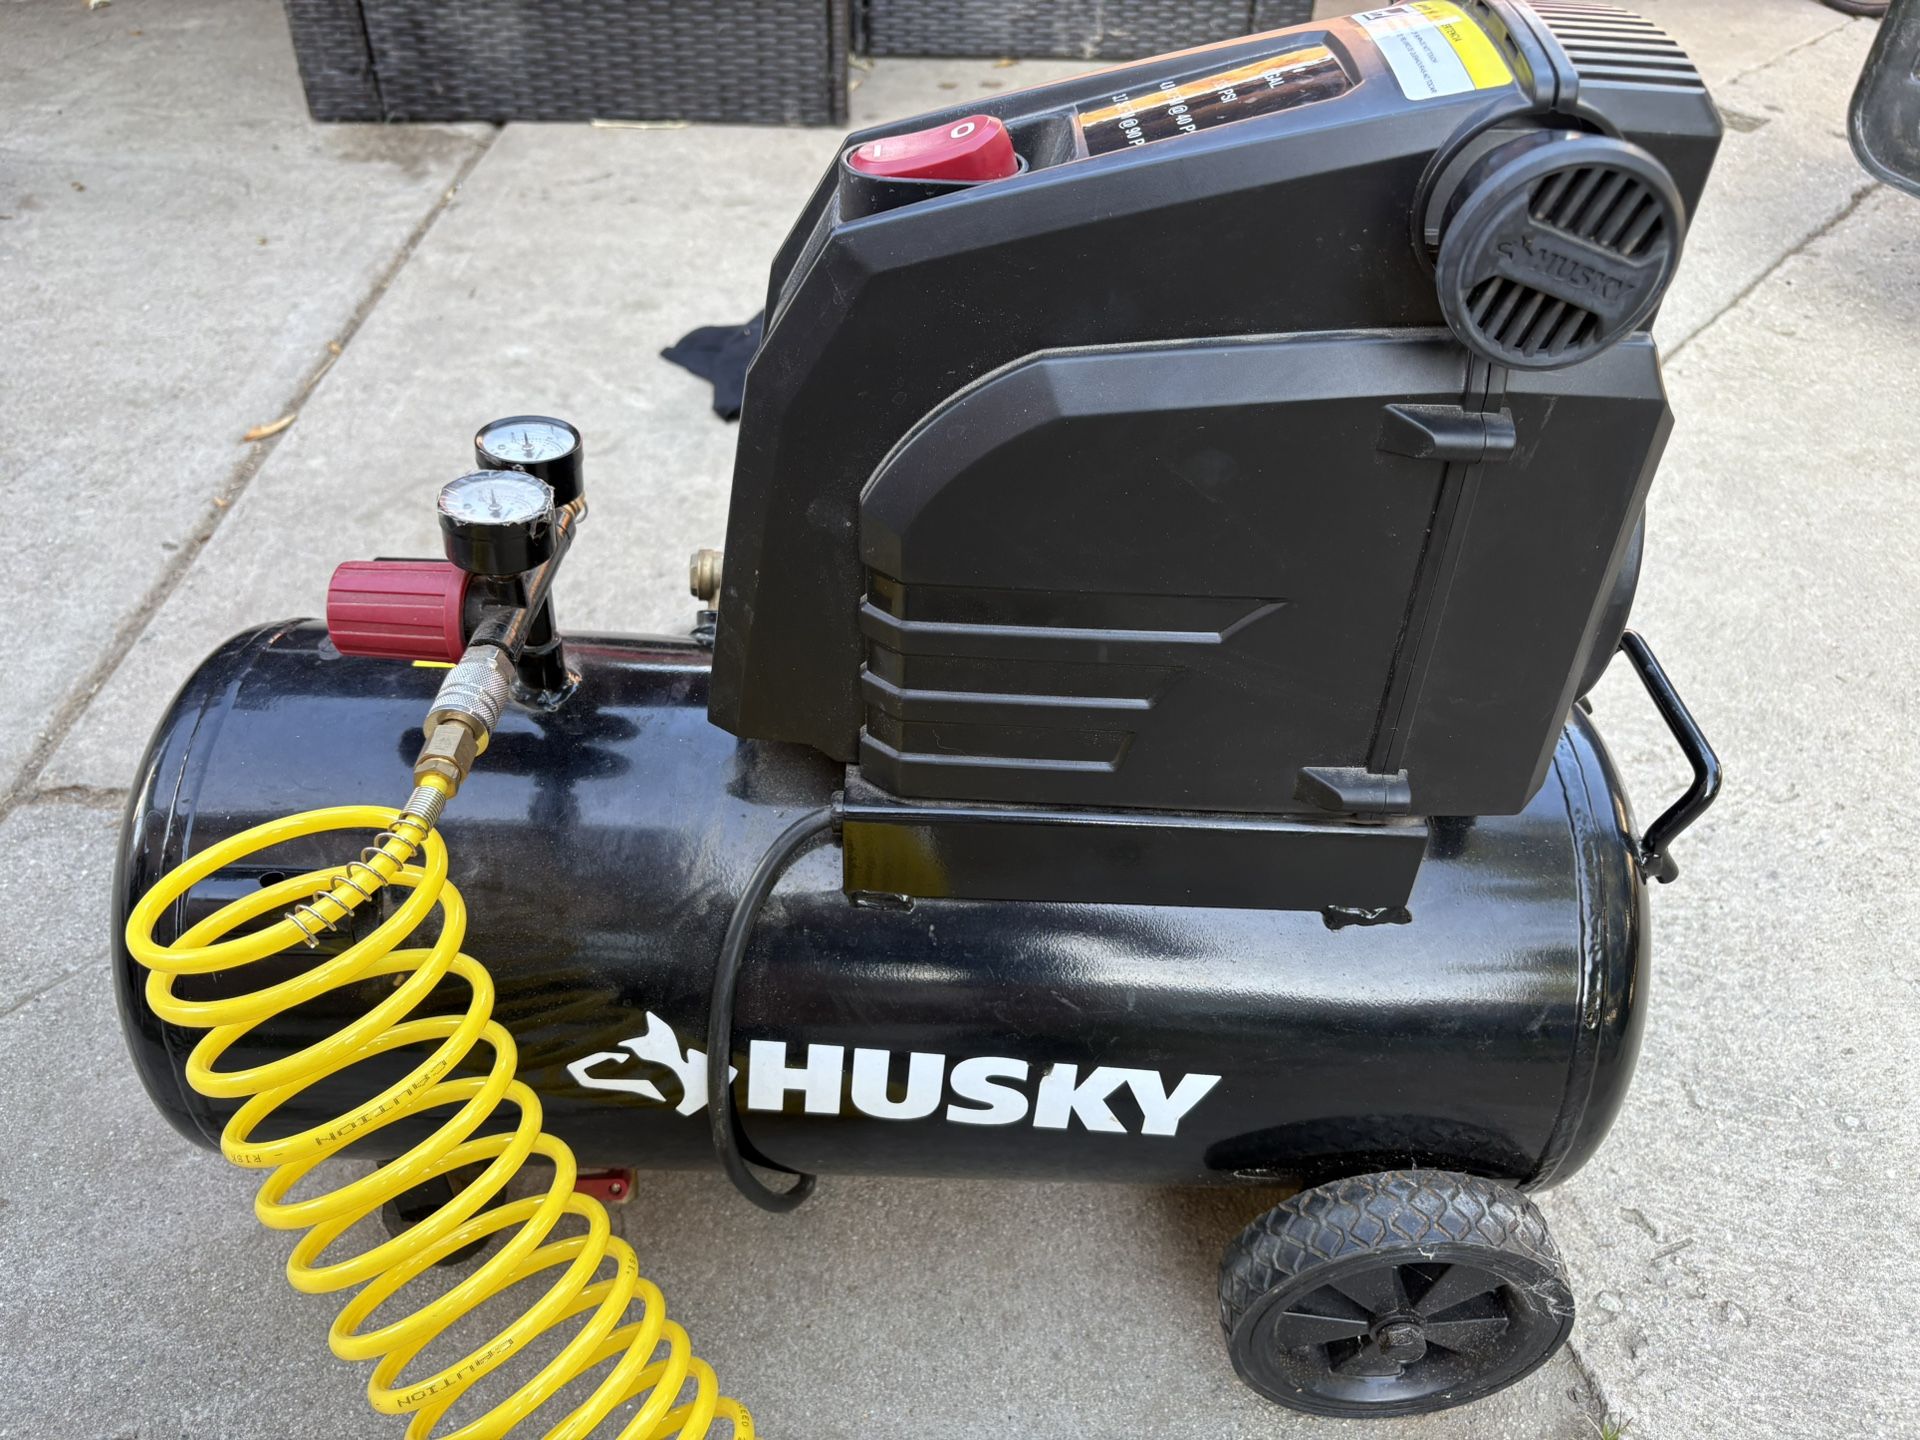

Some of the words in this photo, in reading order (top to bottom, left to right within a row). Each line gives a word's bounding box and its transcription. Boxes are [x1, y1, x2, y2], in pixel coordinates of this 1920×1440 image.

[1217, 88, 1238, 103] PSI
[1125, 126, 1142, 139] 90
[1535, 247, 1636, 303] HUSKY
[314, 1059, 448, 1146] CAUTION
[747, 1039, 1222, 1136] HUSKY
[396, 1338, 514, 1408] CAUTION
